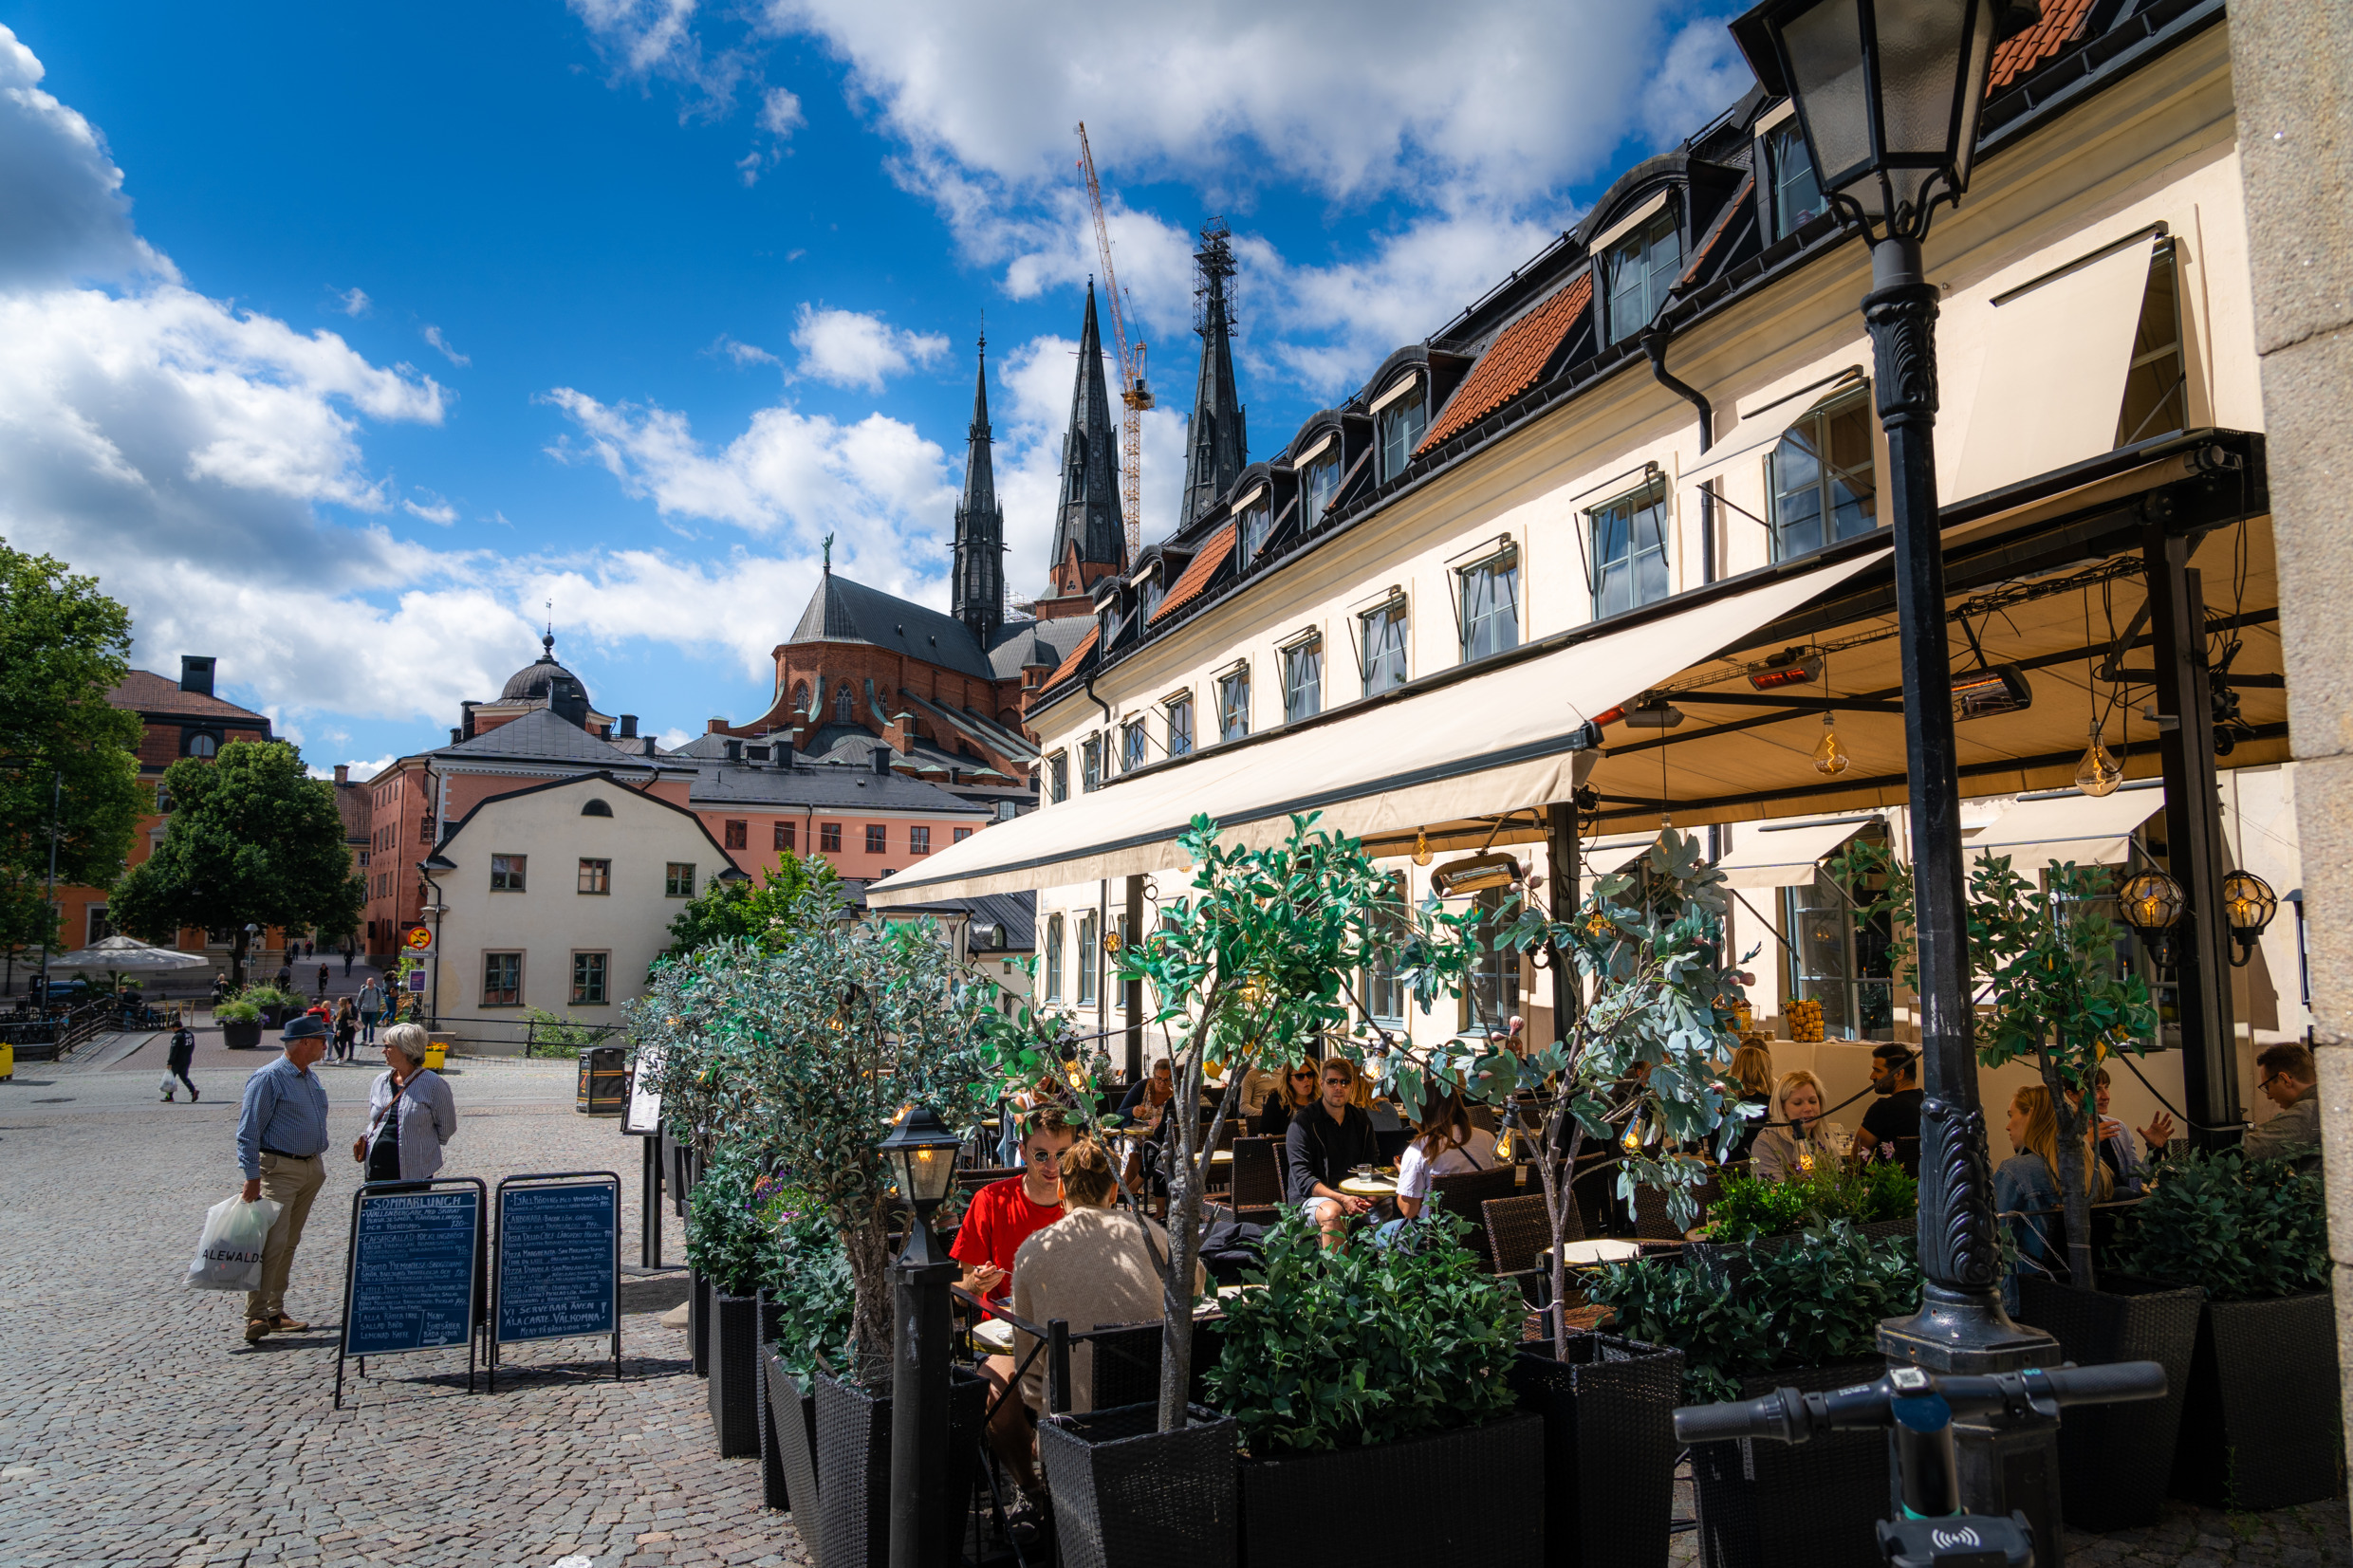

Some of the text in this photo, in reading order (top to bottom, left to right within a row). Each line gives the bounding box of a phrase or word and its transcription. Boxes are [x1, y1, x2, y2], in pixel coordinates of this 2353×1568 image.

[185, 1037, 194, 1046] 19
[373, 1196, 461, 1209] SOMMARLUNCH
[503, 1301, 595, 1317] VI SERVERAR ÄVEN
[361, 1331, 390, 1339] LEMONAD
